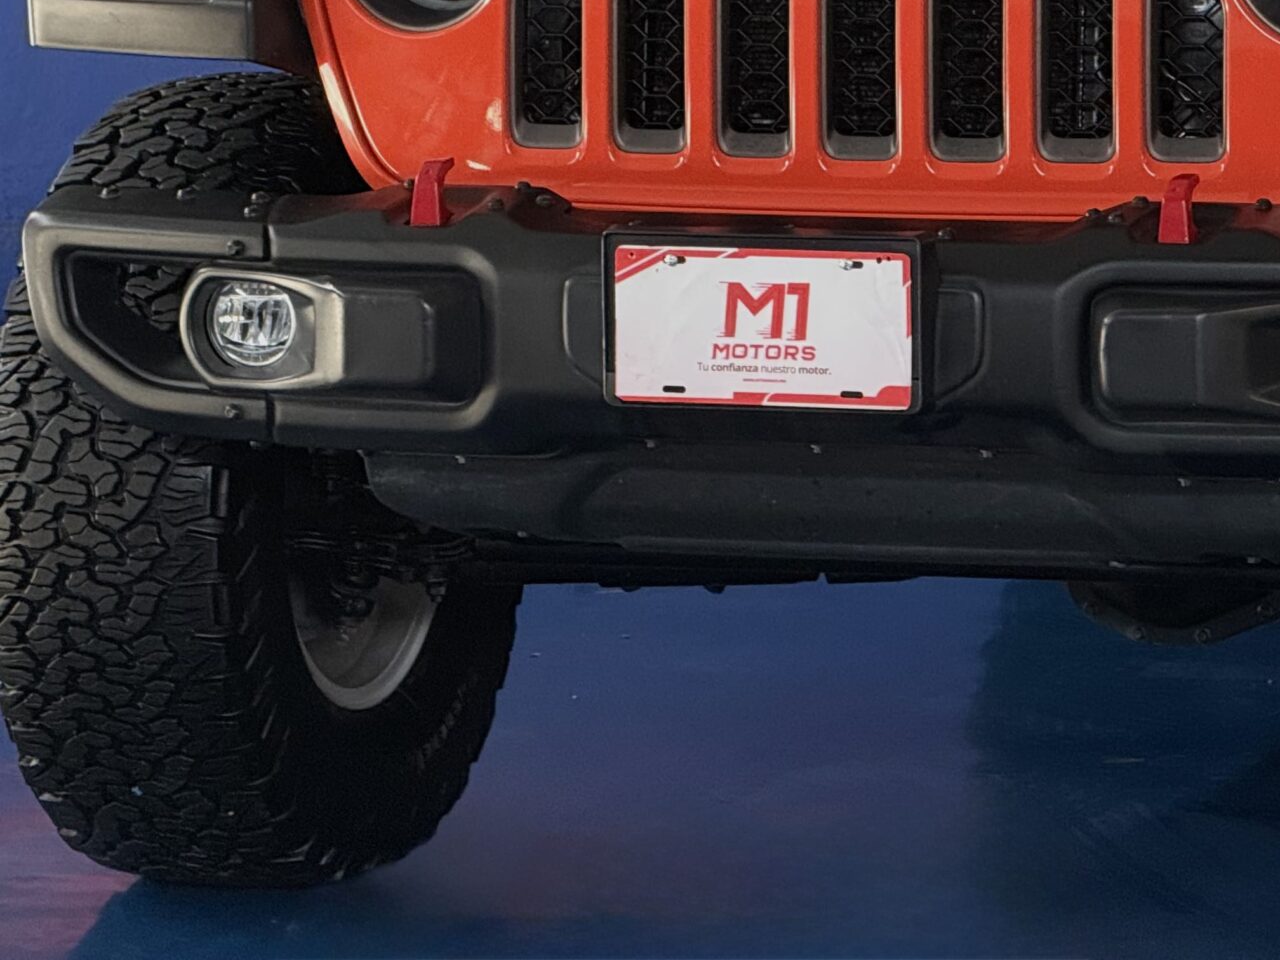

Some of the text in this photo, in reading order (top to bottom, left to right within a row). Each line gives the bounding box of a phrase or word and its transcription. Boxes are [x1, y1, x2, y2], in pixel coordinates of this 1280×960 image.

[716, 281, 811, 341] M1
[711, 343, 817, 361] MOTORS
[697, 362, 832, 375] Tu confianza nuestro motor.
